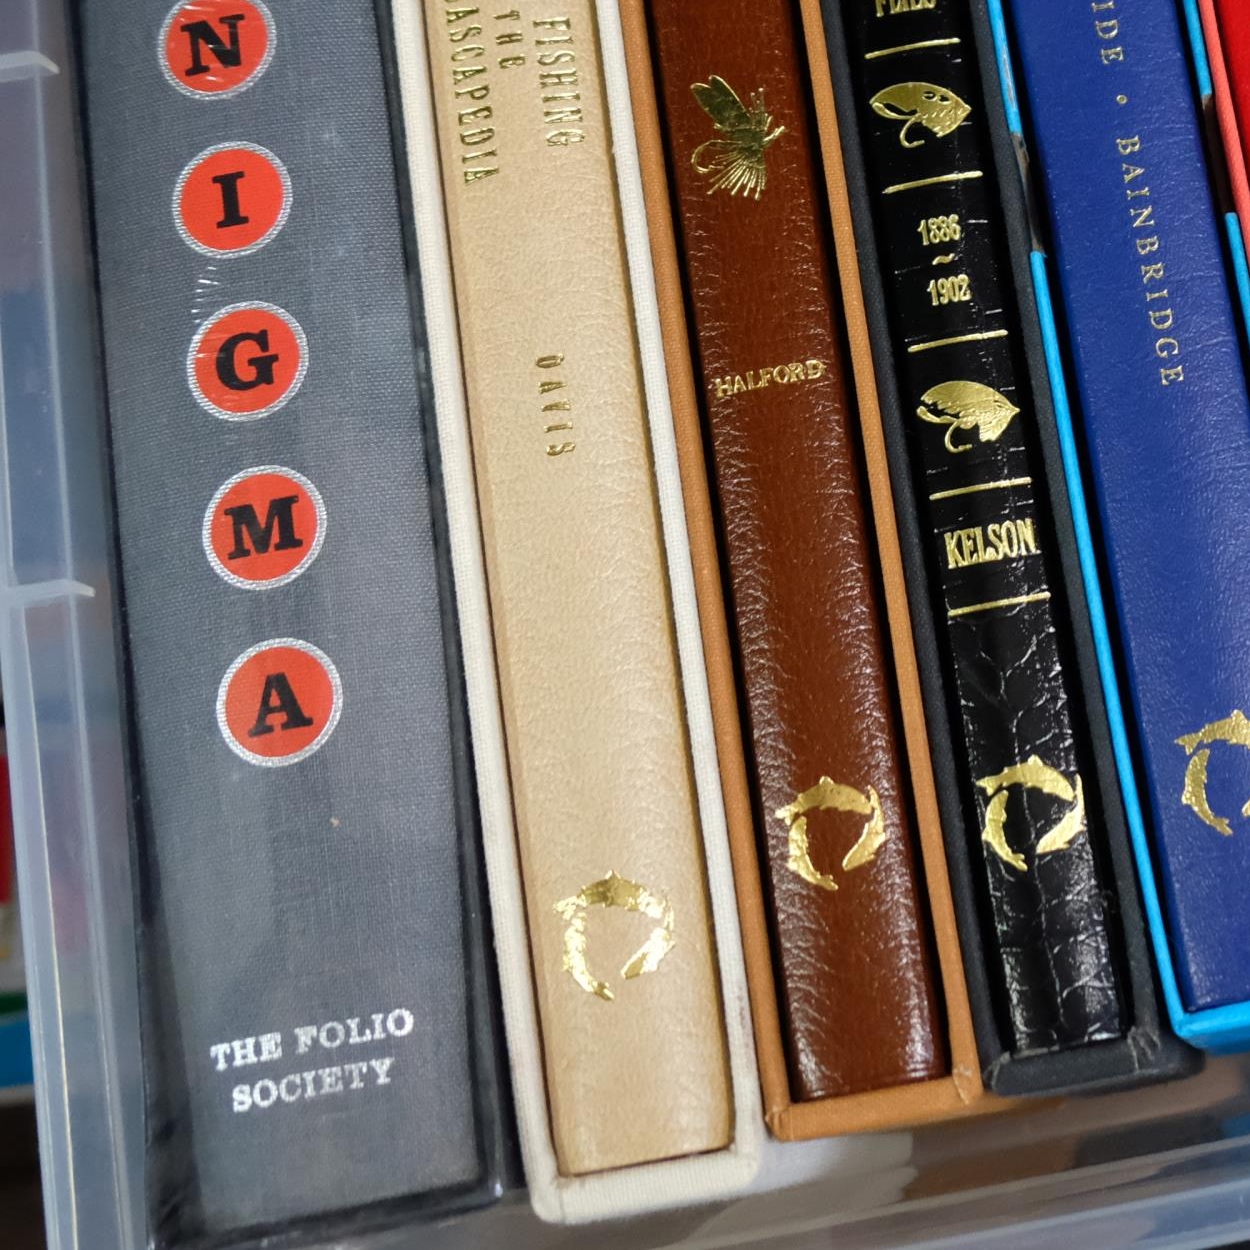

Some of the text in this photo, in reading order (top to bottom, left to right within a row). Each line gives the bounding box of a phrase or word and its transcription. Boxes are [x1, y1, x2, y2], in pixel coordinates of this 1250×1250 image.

[493, 9, 526, 69] THE
[533, 17, 586, 147] FISHING
[917, 213, 961, 246] 1886
[1113, 135, 1185, 386] BAINBRIDGE
[927, 274, 971, 306] 1902
[715, 359, 827, 398] HALFORD
[943, 517, 1038, 569] KELSON
[210, 1007, 414, 1072] THE FOLIO
[232, 1057, 395, 1113] SOCIETY
